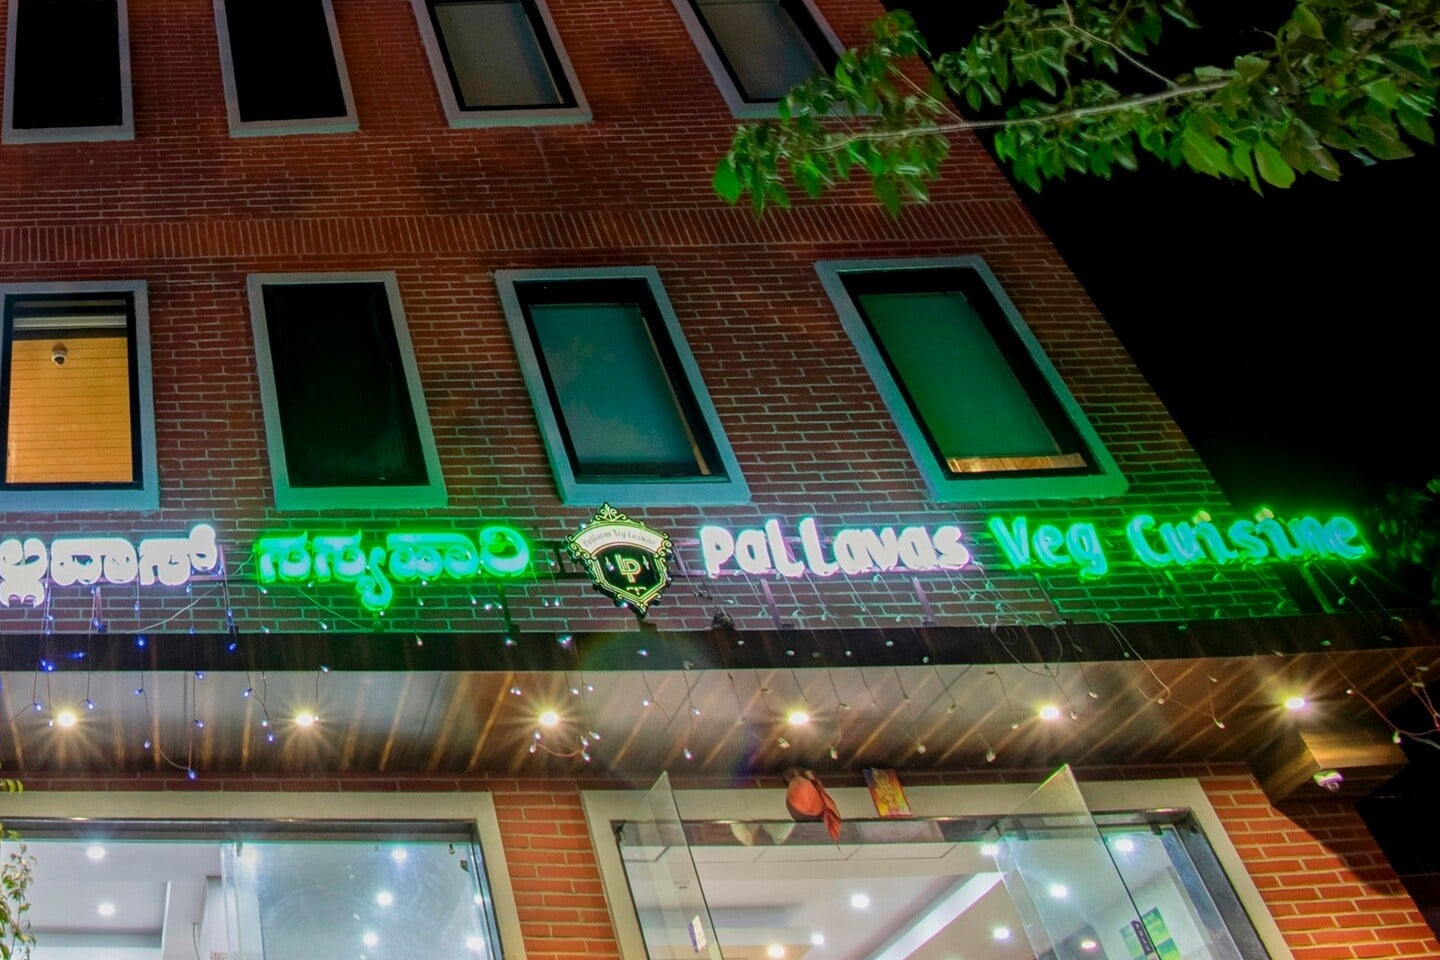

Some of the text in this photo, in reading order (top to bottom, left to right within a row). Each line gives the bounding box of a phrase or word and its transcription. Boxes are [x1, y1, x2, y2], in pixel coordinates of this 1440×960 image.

[700, 506, 1374, 582] Pallavas Veg Cuisine
